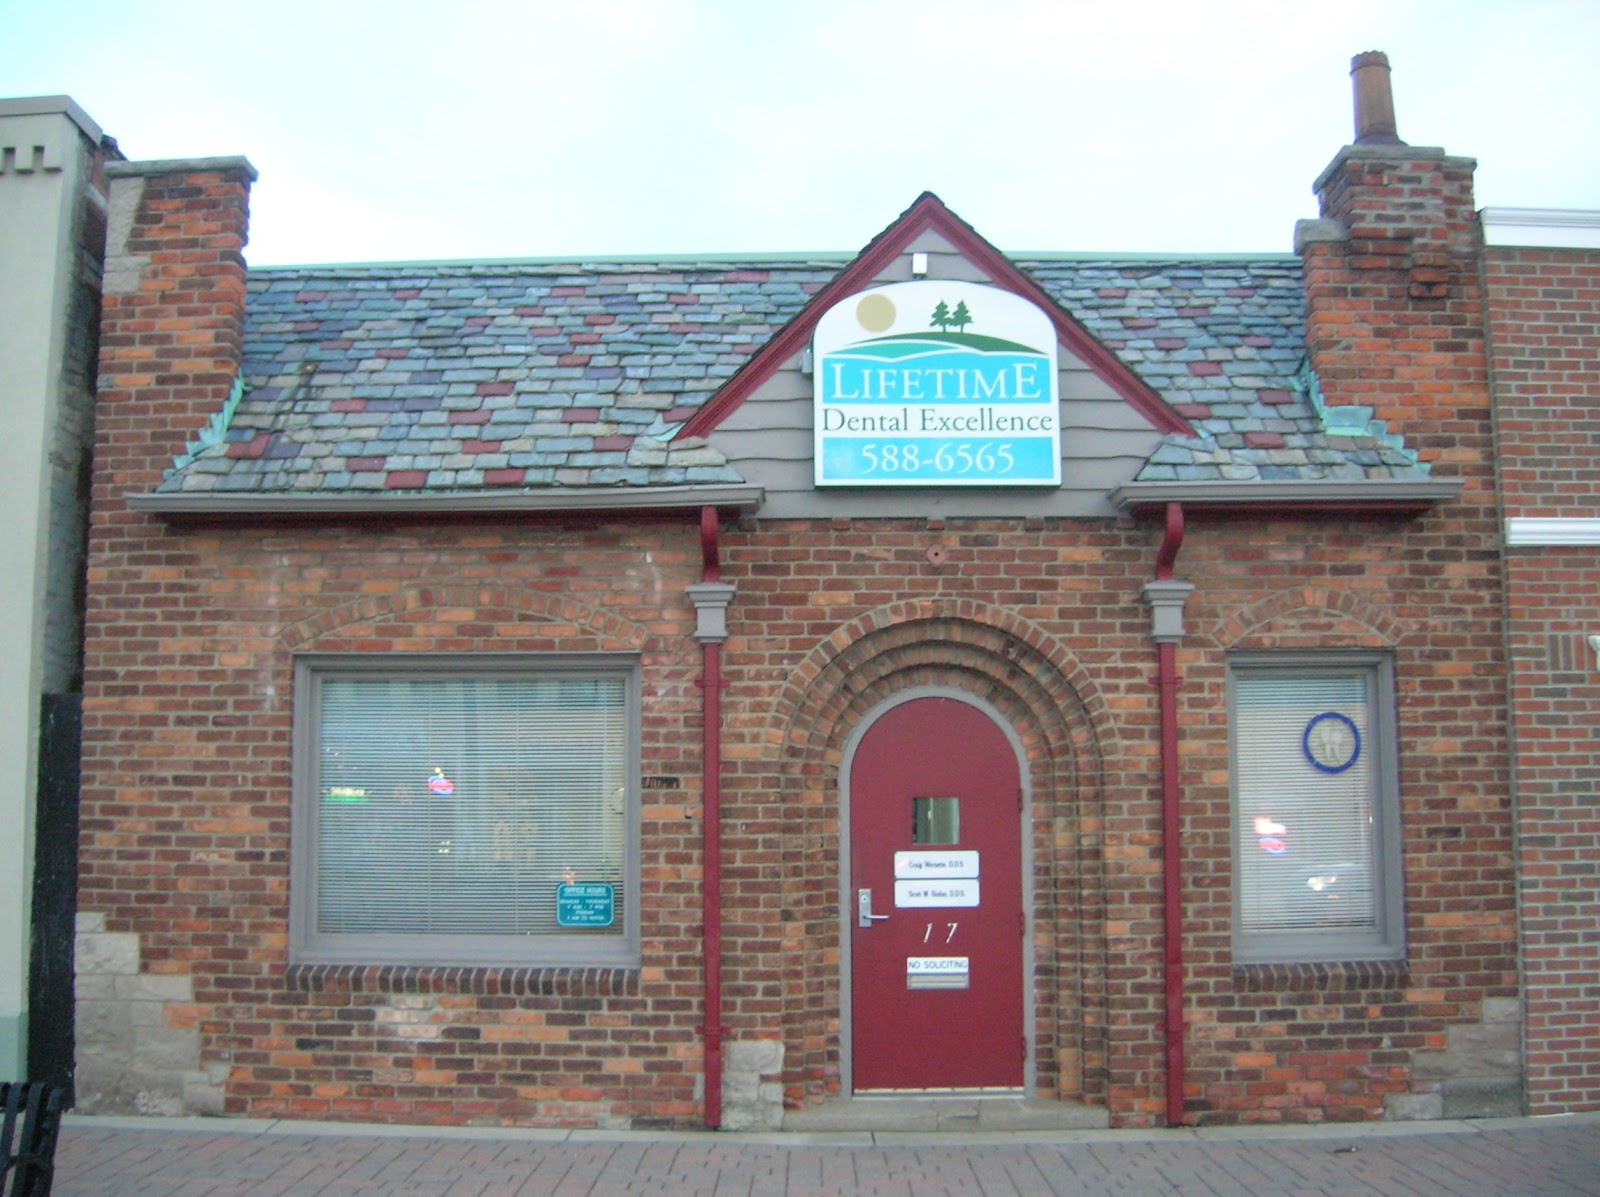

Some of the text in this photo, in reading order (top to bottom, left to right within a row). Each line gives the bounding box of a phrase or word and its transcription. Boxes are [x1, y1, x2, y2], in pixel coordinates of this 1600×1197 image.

[830, 362, 1042, 399] LIFETIME
[823, 407, 1053, 432] Dental Excellence
[861, 442, 1014, 475] 588-6565
[909, 960, 967, 969] NO SOLICITING
